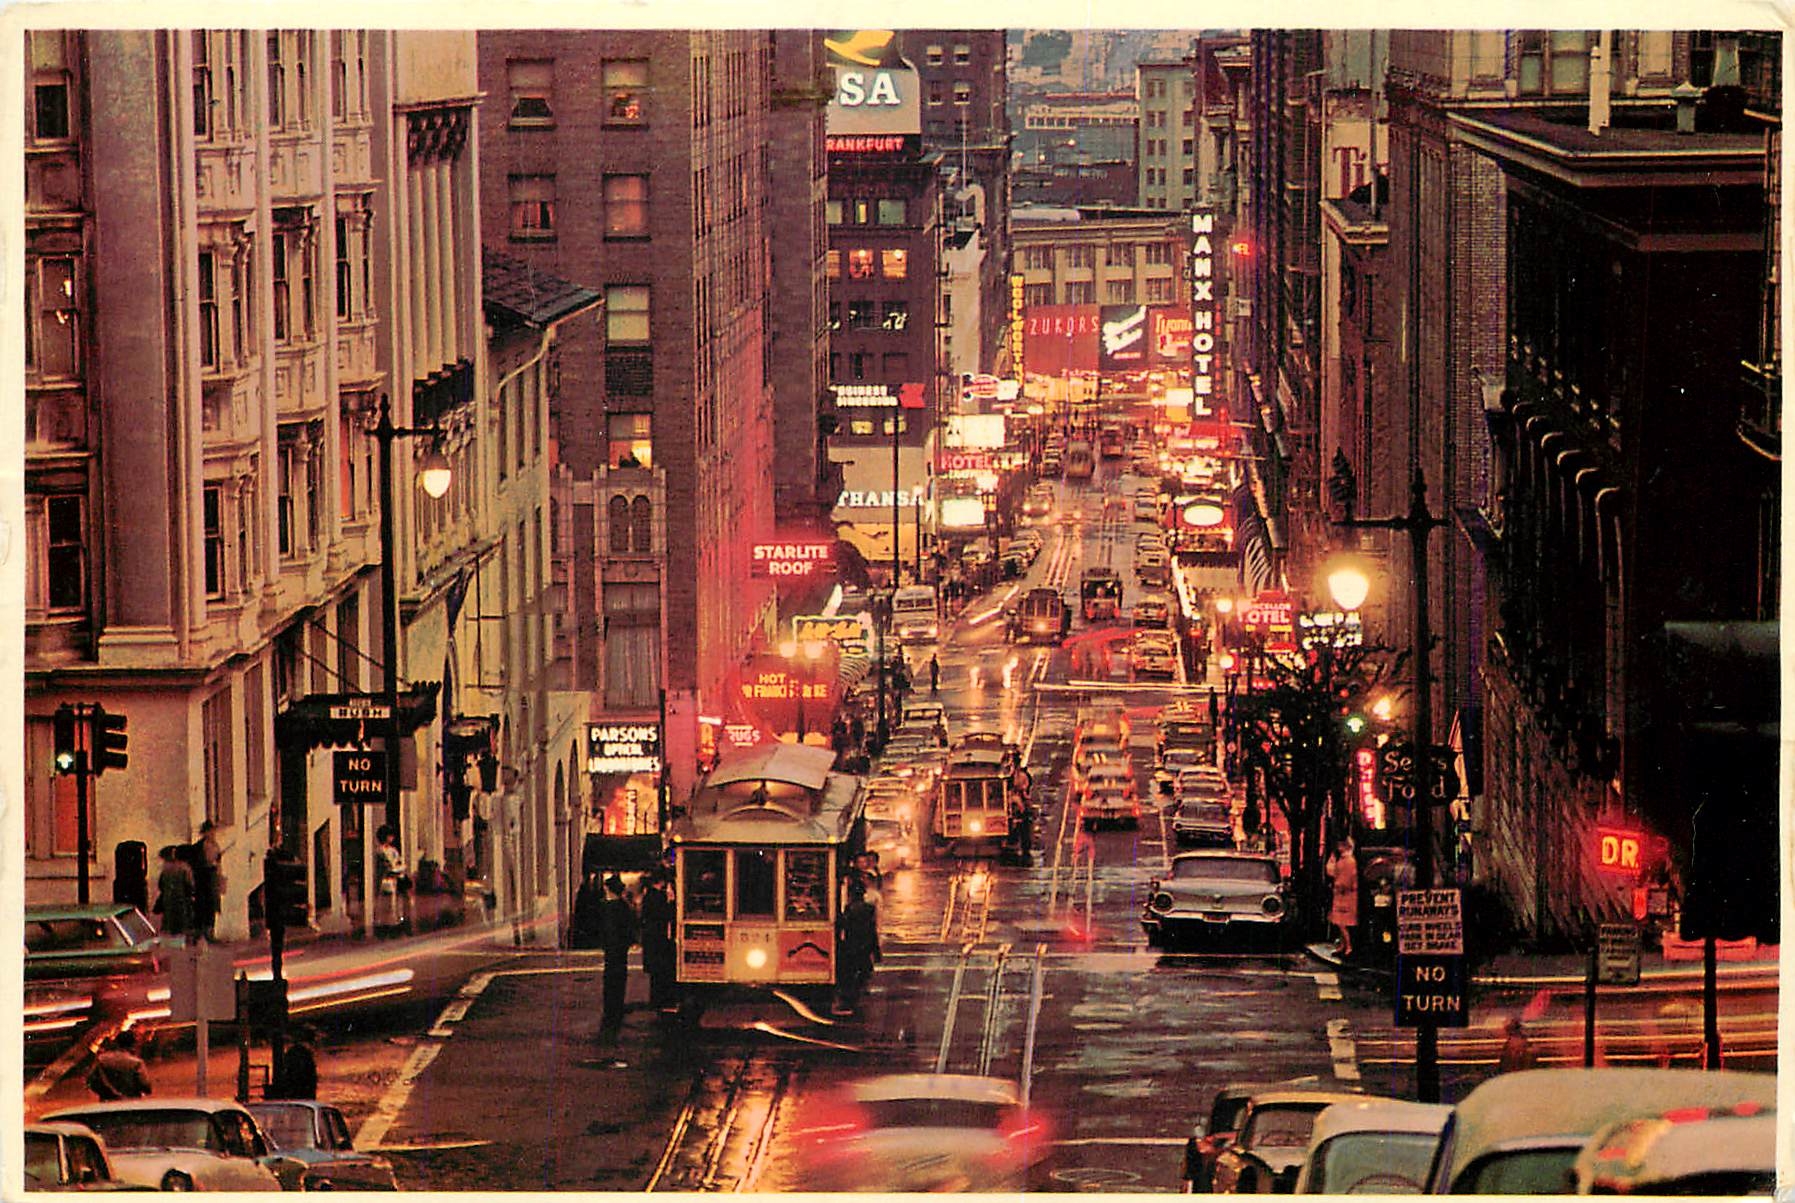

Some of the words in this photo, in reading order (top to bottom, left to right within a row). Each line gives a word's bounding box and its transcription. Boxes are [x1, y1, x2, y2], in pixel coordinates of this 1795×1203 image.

[1193, 214, 1214, 300] MANX
[1030, 315, 1100, 335] ZUKORS
[1193, 311, 1214, 416] HOTEL
[941, 455, 993, 469] HOTEL
[754, 545, 829, 559] STARLITE
[768, 561, 813, 575] ROOF
[759, 674, 785, 684] HOT
[591, 727, 658, 742] PARSONS
[349, 757, 371, 771] NO
[340, 780, 382, 793] TURN
[1402, 893, 1455, 904] PREVENT
[1400, 905, 1459, 916] RUNAWAYS
[1416, 966, 1446, 982] NO
[1402, 995, 1460, 1012] TURN
